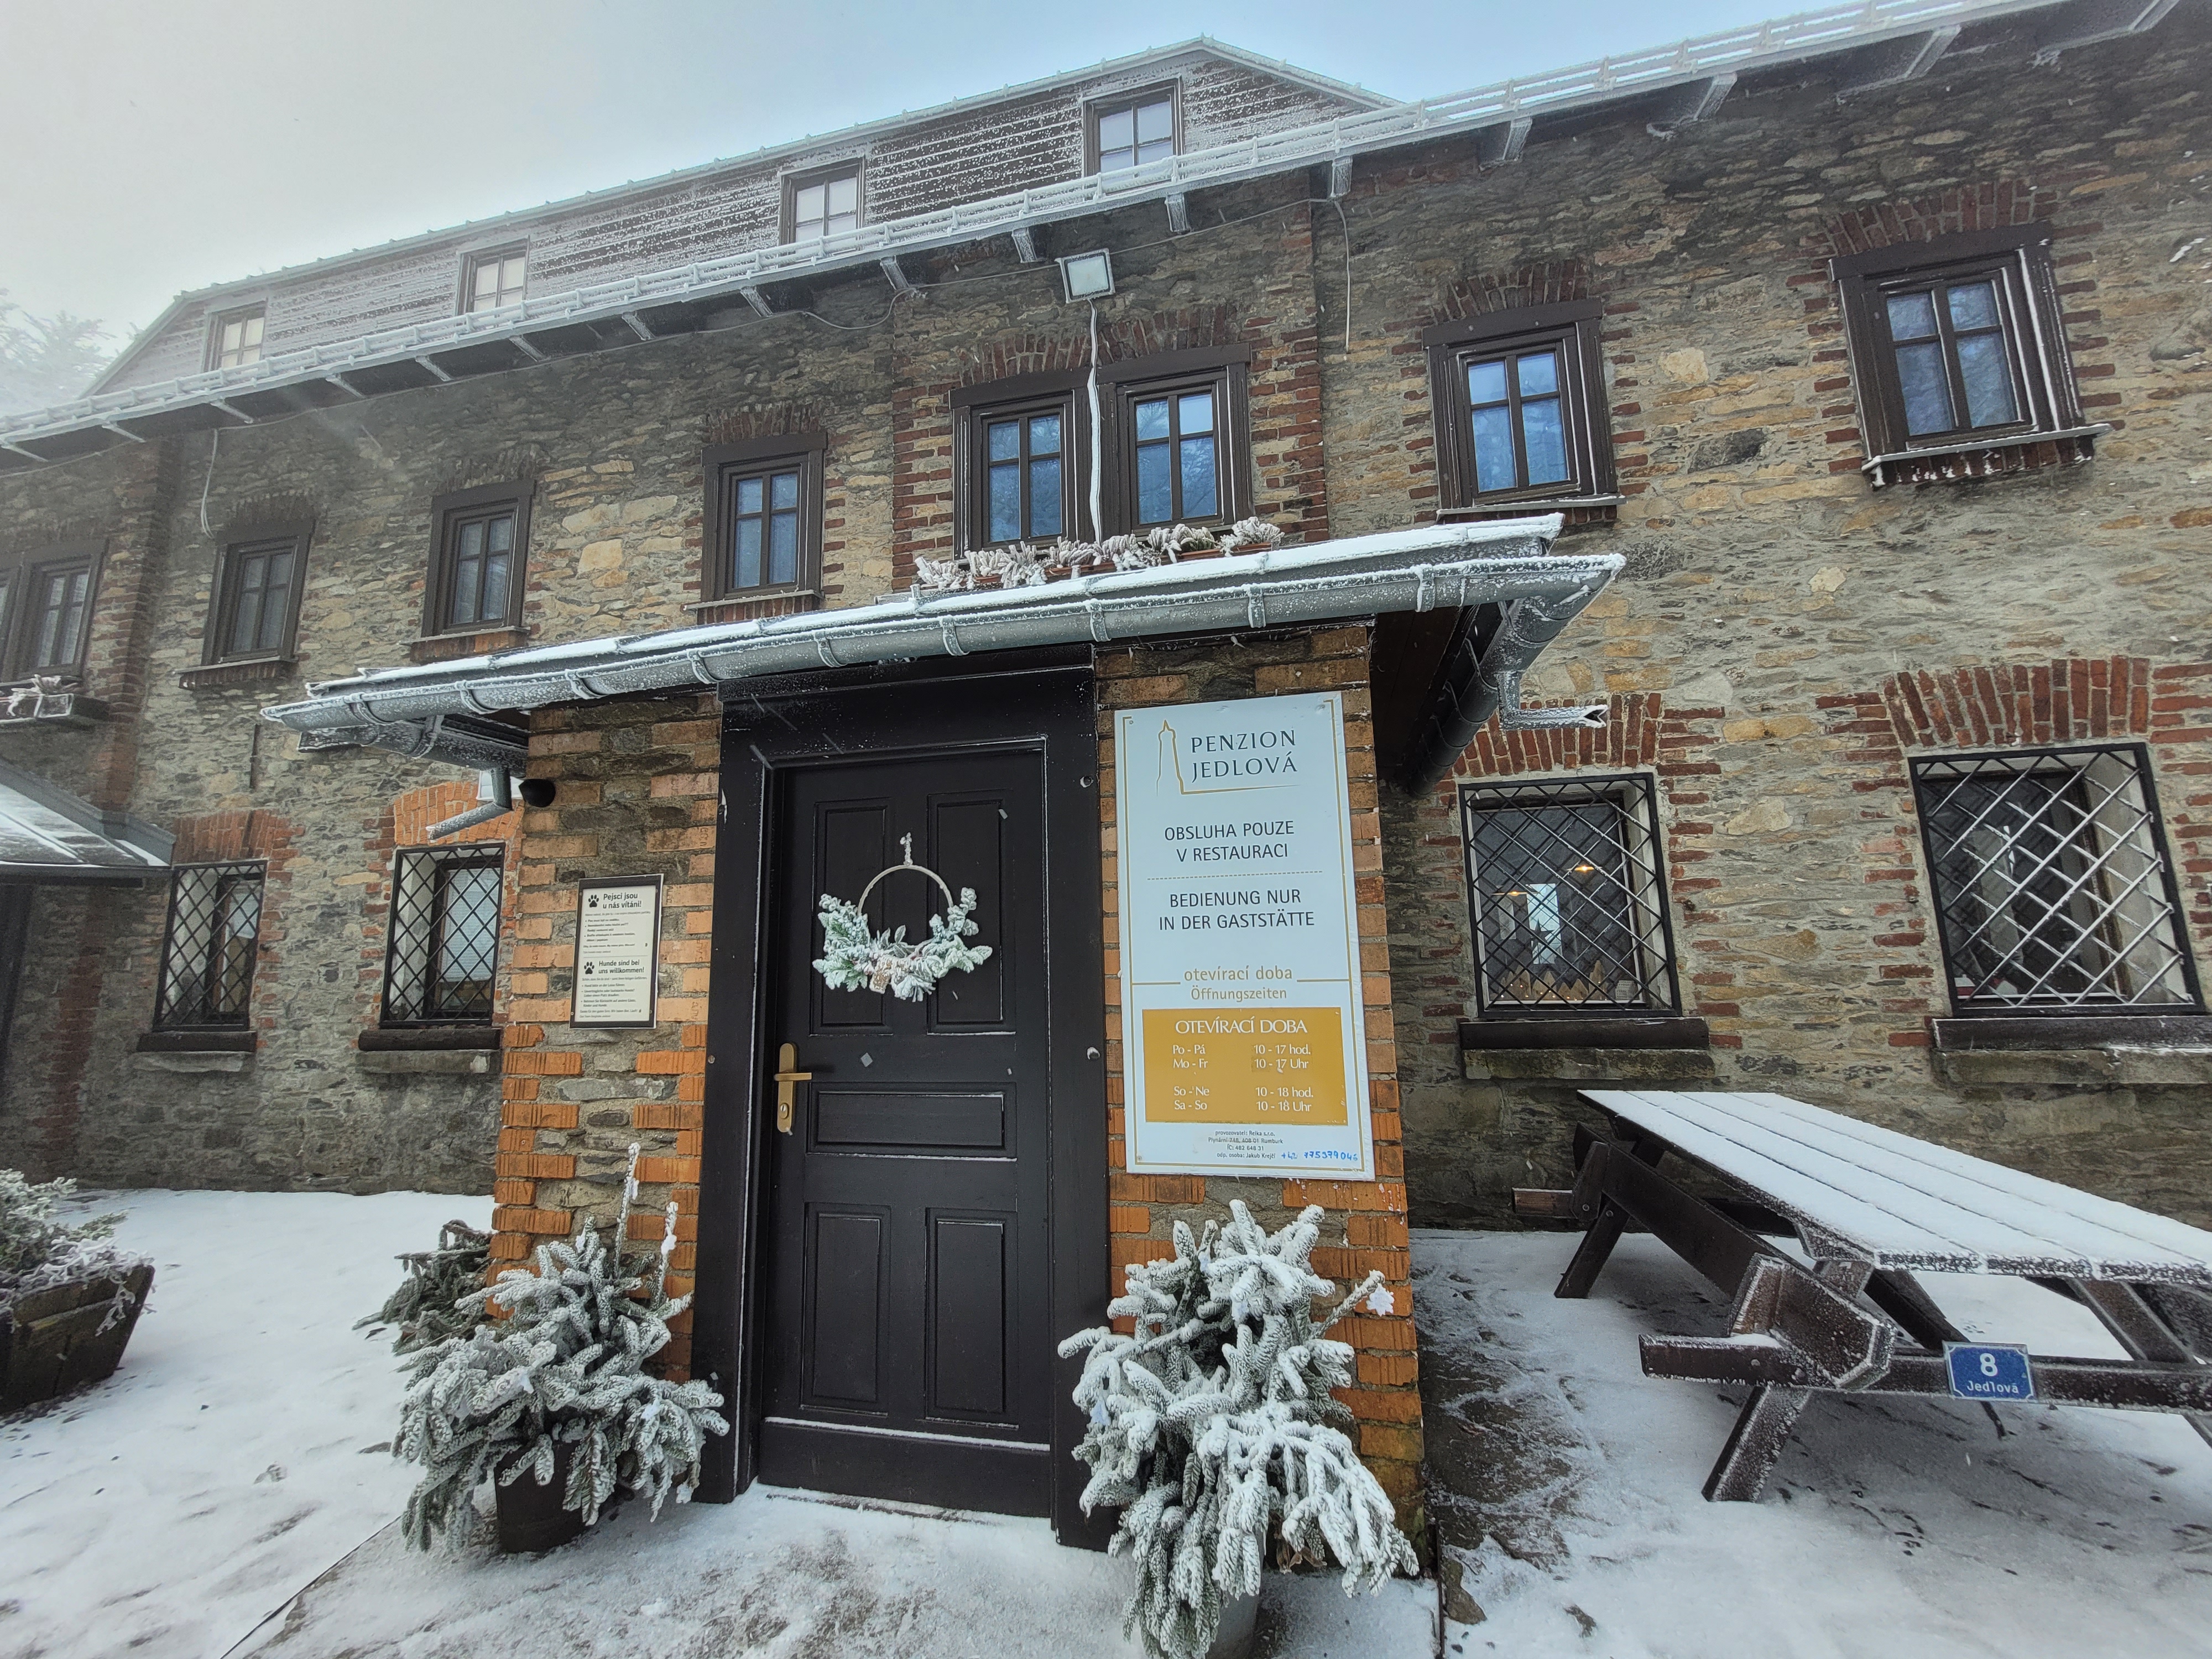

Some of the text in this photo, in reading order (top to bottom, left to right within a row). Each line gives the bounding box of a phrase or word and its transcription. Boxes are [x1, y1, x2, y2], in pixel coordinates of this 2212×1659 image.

[1191, 730, 1296, 753] PENZION
[1192, 752, 1297, 782] JEDLOVÁ
[1165, 821, 1294, 840] OBSLUHA POUZE
[1177, 844, 1287, 862] V RESTAURACI
[603, 893, 623, 901] Pejsci
[1171, 889, 1301, 907] BEDIENUNG NUR
[1160, 909, 1314, 930] IN DER GASTSTÄTTE
[1185, 966, 1292, 981] otevírací doba
[1191, 985, 1286, 1002] Öffnungszeiten
[1175, 1016, 1307, 1033] OTEVÍRACÍ DOBA
[1172, 1045, 1185, 1054] Po
[1194, 1045, 1206, 1054] Pá
[1254, 1045, 1265, 1054] 10
[1276, 1045, 1286, 1054] 17
[1289, 1044, 1310, 1054] hod.
[1173, 1059, 1189, 1068] Mo
[1199, 1058, 1208, 1068] Fr
[1255, 1059, 1266, 1068] 10
[1276, 1059, 1286, 1068] 17
[1290, 1058, 1308, 1068] Uhr
[1175, 1086, 1186, 1095] So
[1196, 1087, 1209, 1095] Ne
[1256, 1087, 1267, 1096] 10
[1277, 1088, 1288, 1097] 18
[1292, 1087, 1313, 1097] hod.
[1175, 1100, 1185, 1109] Sa
[1195, 1100, 1207, 1109] So
[1256, 1102, 1267, 1110] 10
[1279, 1101, 1289, 1110] 18
[1292, 1101, 1311, 1111] Uhr
[1980, 1353, 1997, 1376] 8
